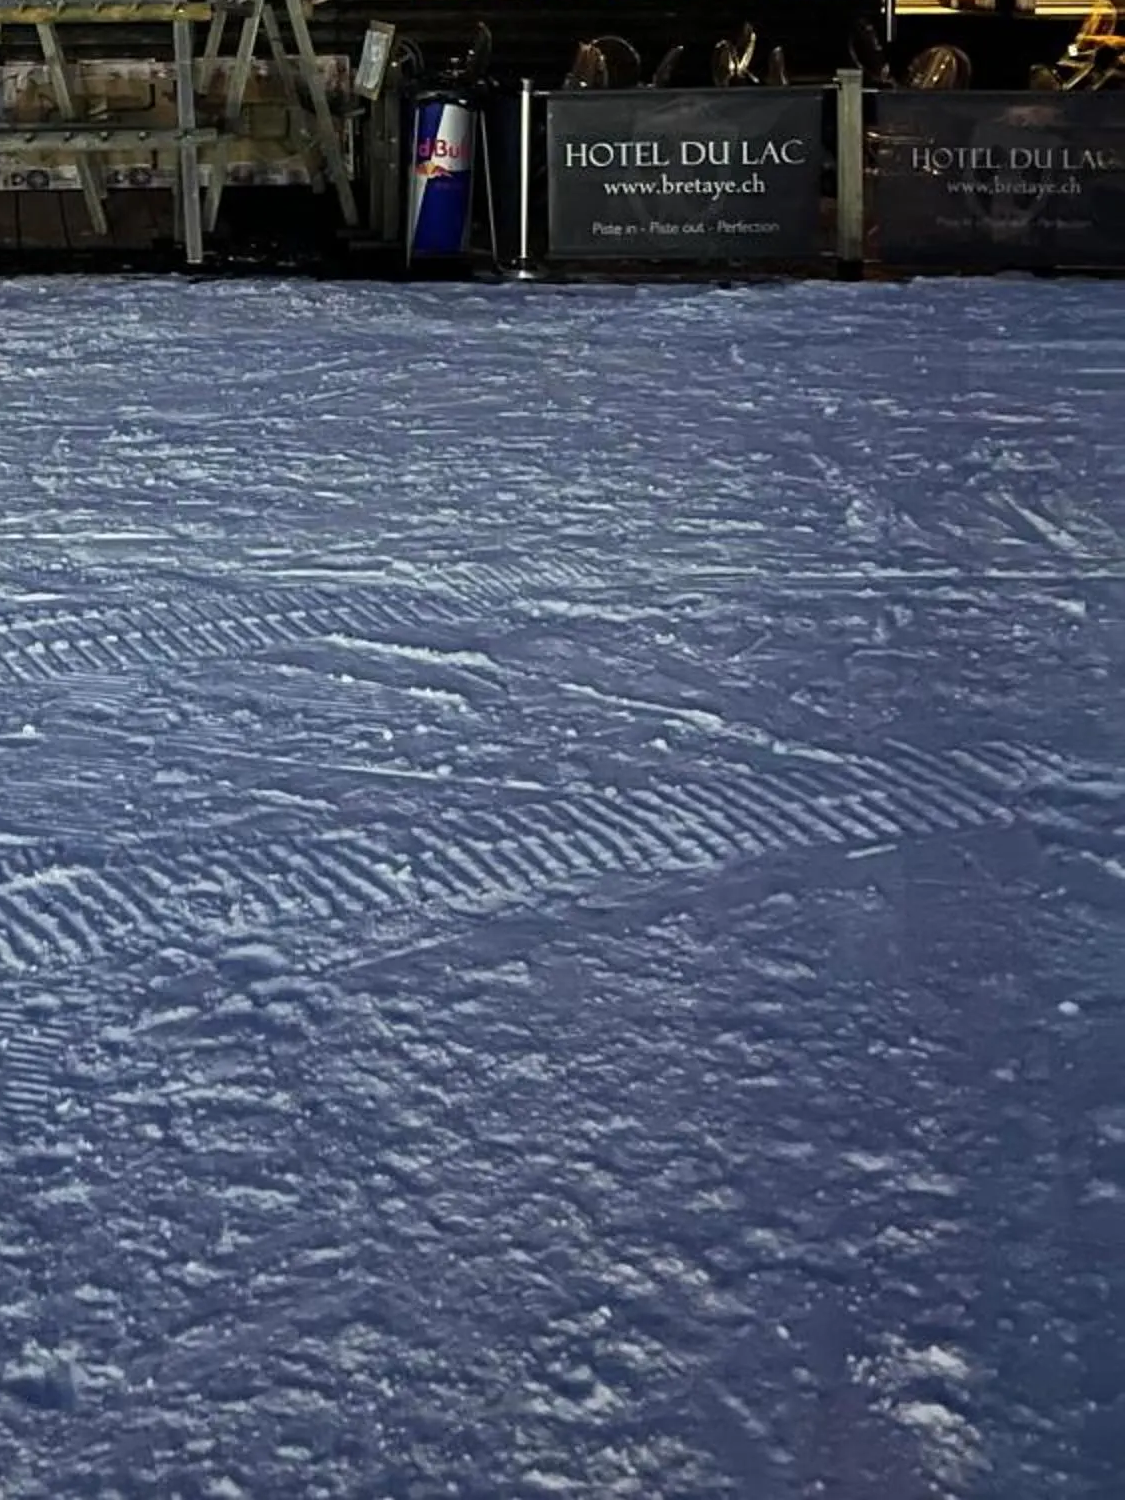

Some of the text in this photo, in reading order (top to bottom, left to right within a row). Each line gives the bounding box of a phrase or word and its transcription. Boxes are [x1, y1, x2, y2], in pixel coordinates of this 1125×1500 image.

[565, 140, 805, 167] HOTEL DU LAC
[912, 148, 1000, 169] HOTEL
[1009, 148, 1052, 169] DU
[604, 173, 766, 201] www.bretaye.ch
[947, 176, 1081, 201] www.bretaye.ch
